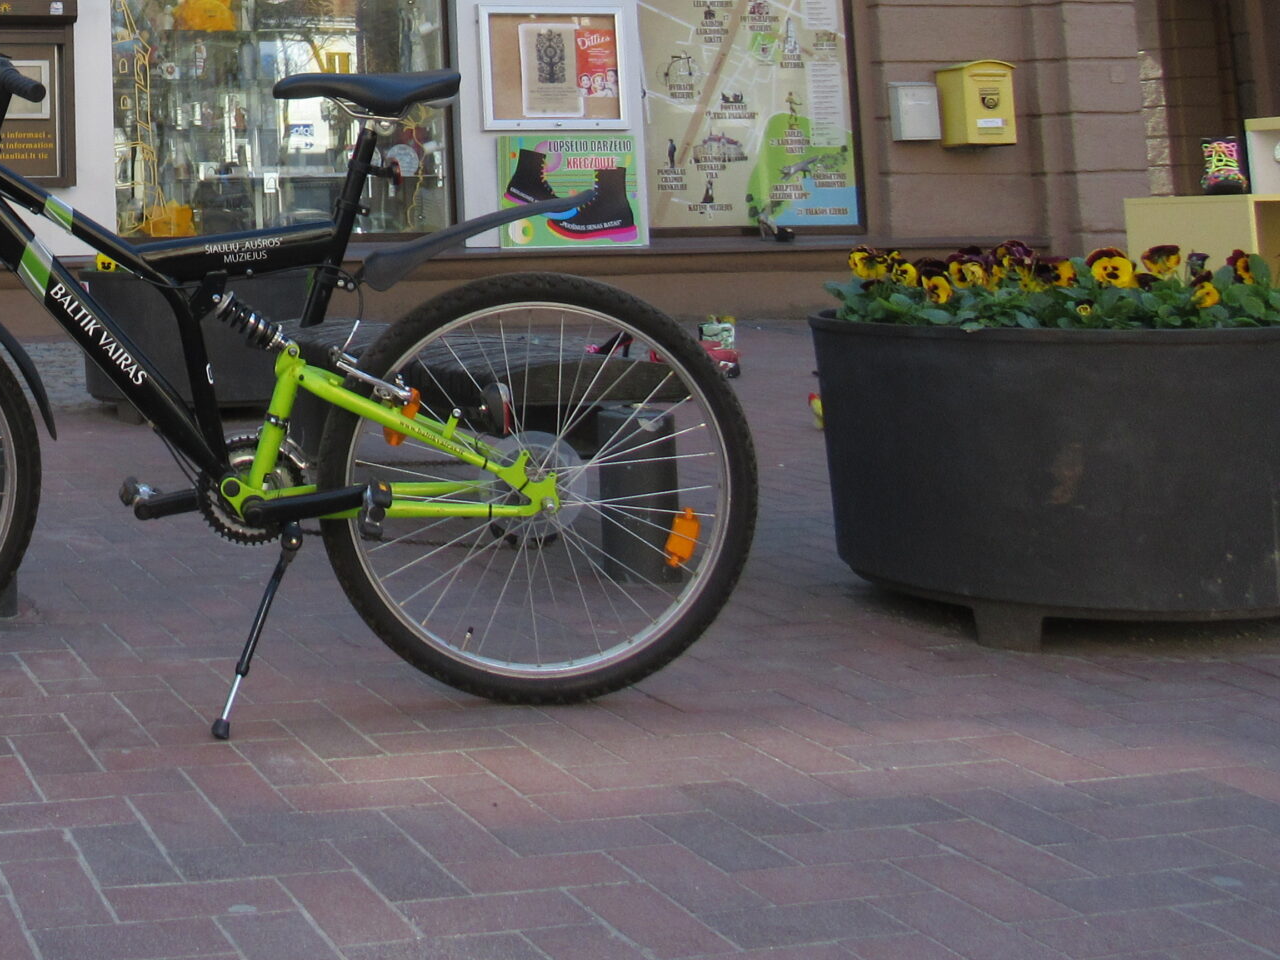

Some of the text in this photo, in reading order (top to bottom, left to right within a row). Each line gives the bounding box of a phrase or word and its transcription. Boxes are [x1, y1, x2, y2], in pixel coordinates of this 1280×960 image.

[223, 250, 268, 264] MUZIEJUS
[49, 282, 148, 385] BALTIK VAIRAS
